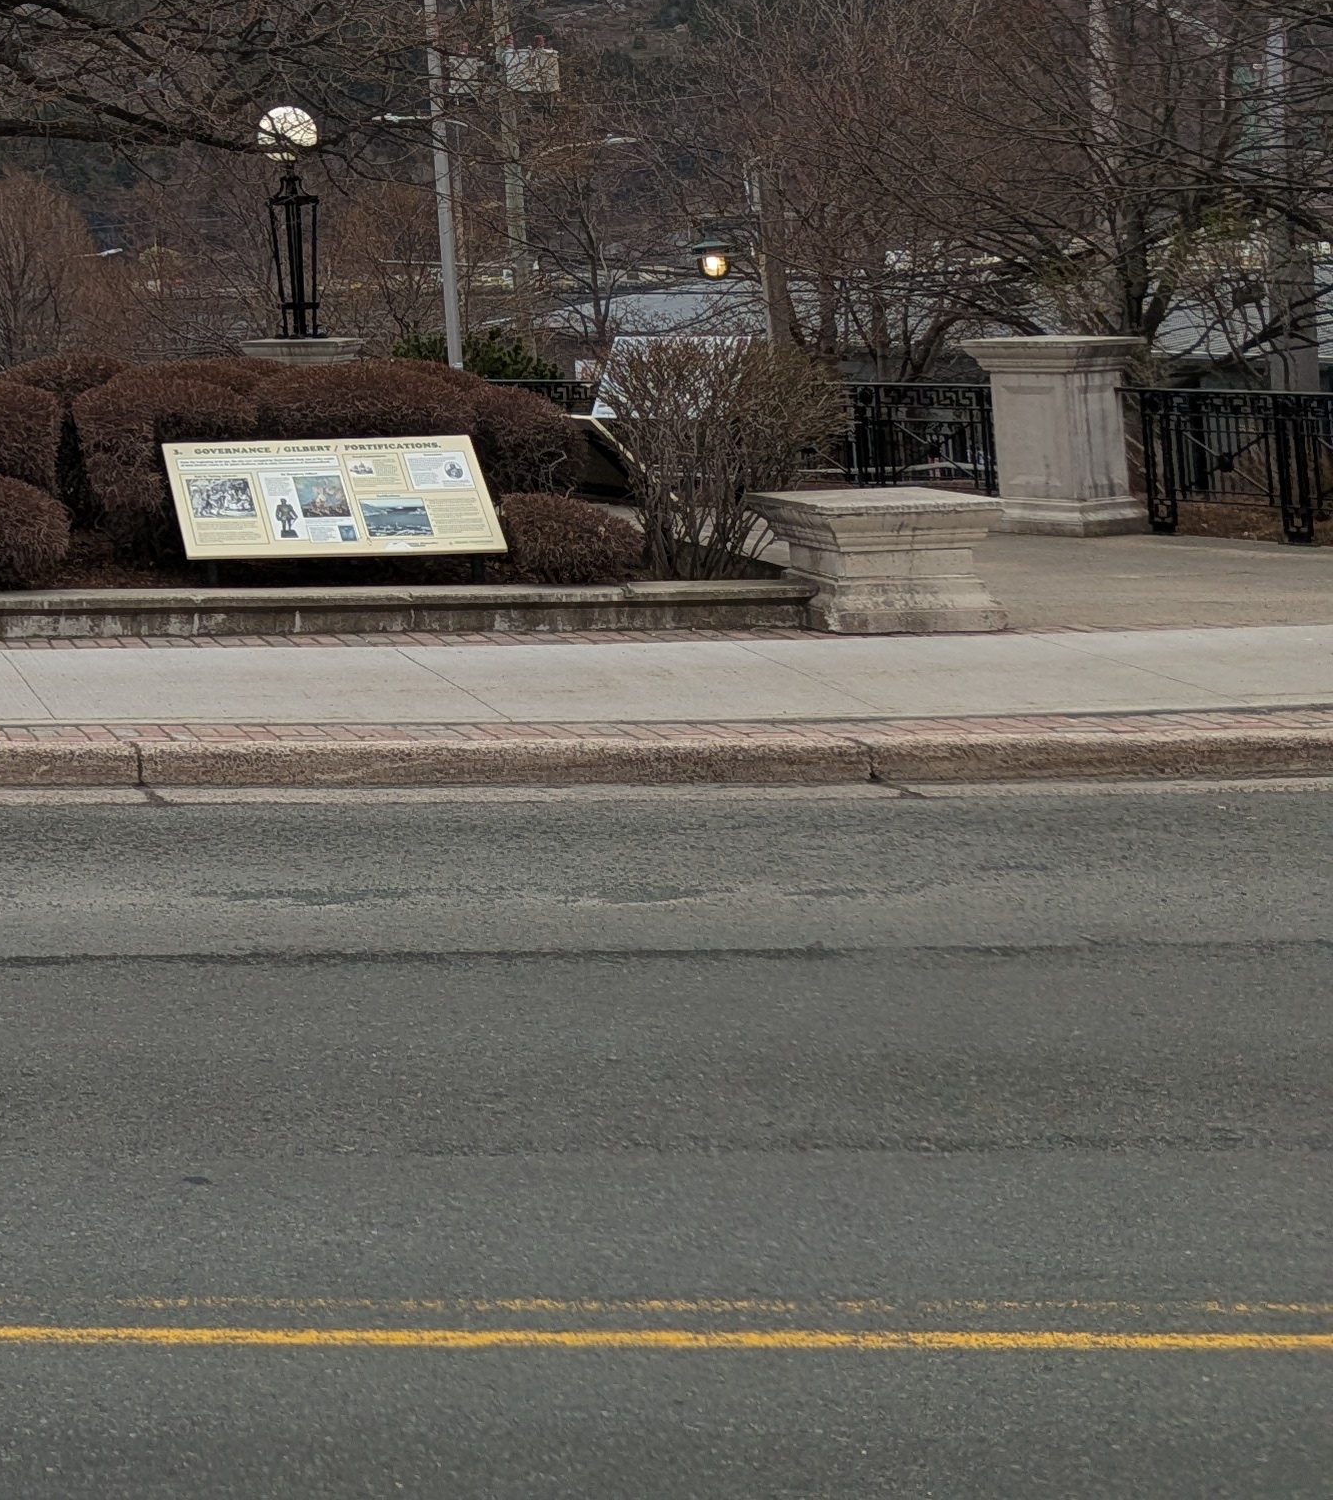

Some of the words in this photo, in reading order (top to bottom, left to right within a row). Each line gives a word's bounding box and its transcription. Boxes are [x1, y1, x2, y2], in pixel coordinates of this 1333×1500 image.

[194, 446, 272, 455] GOVERNANCE
[283, 445, 331, 453] GILBERT
[344, 442, 441, 451] FORTIFICATIONS.
